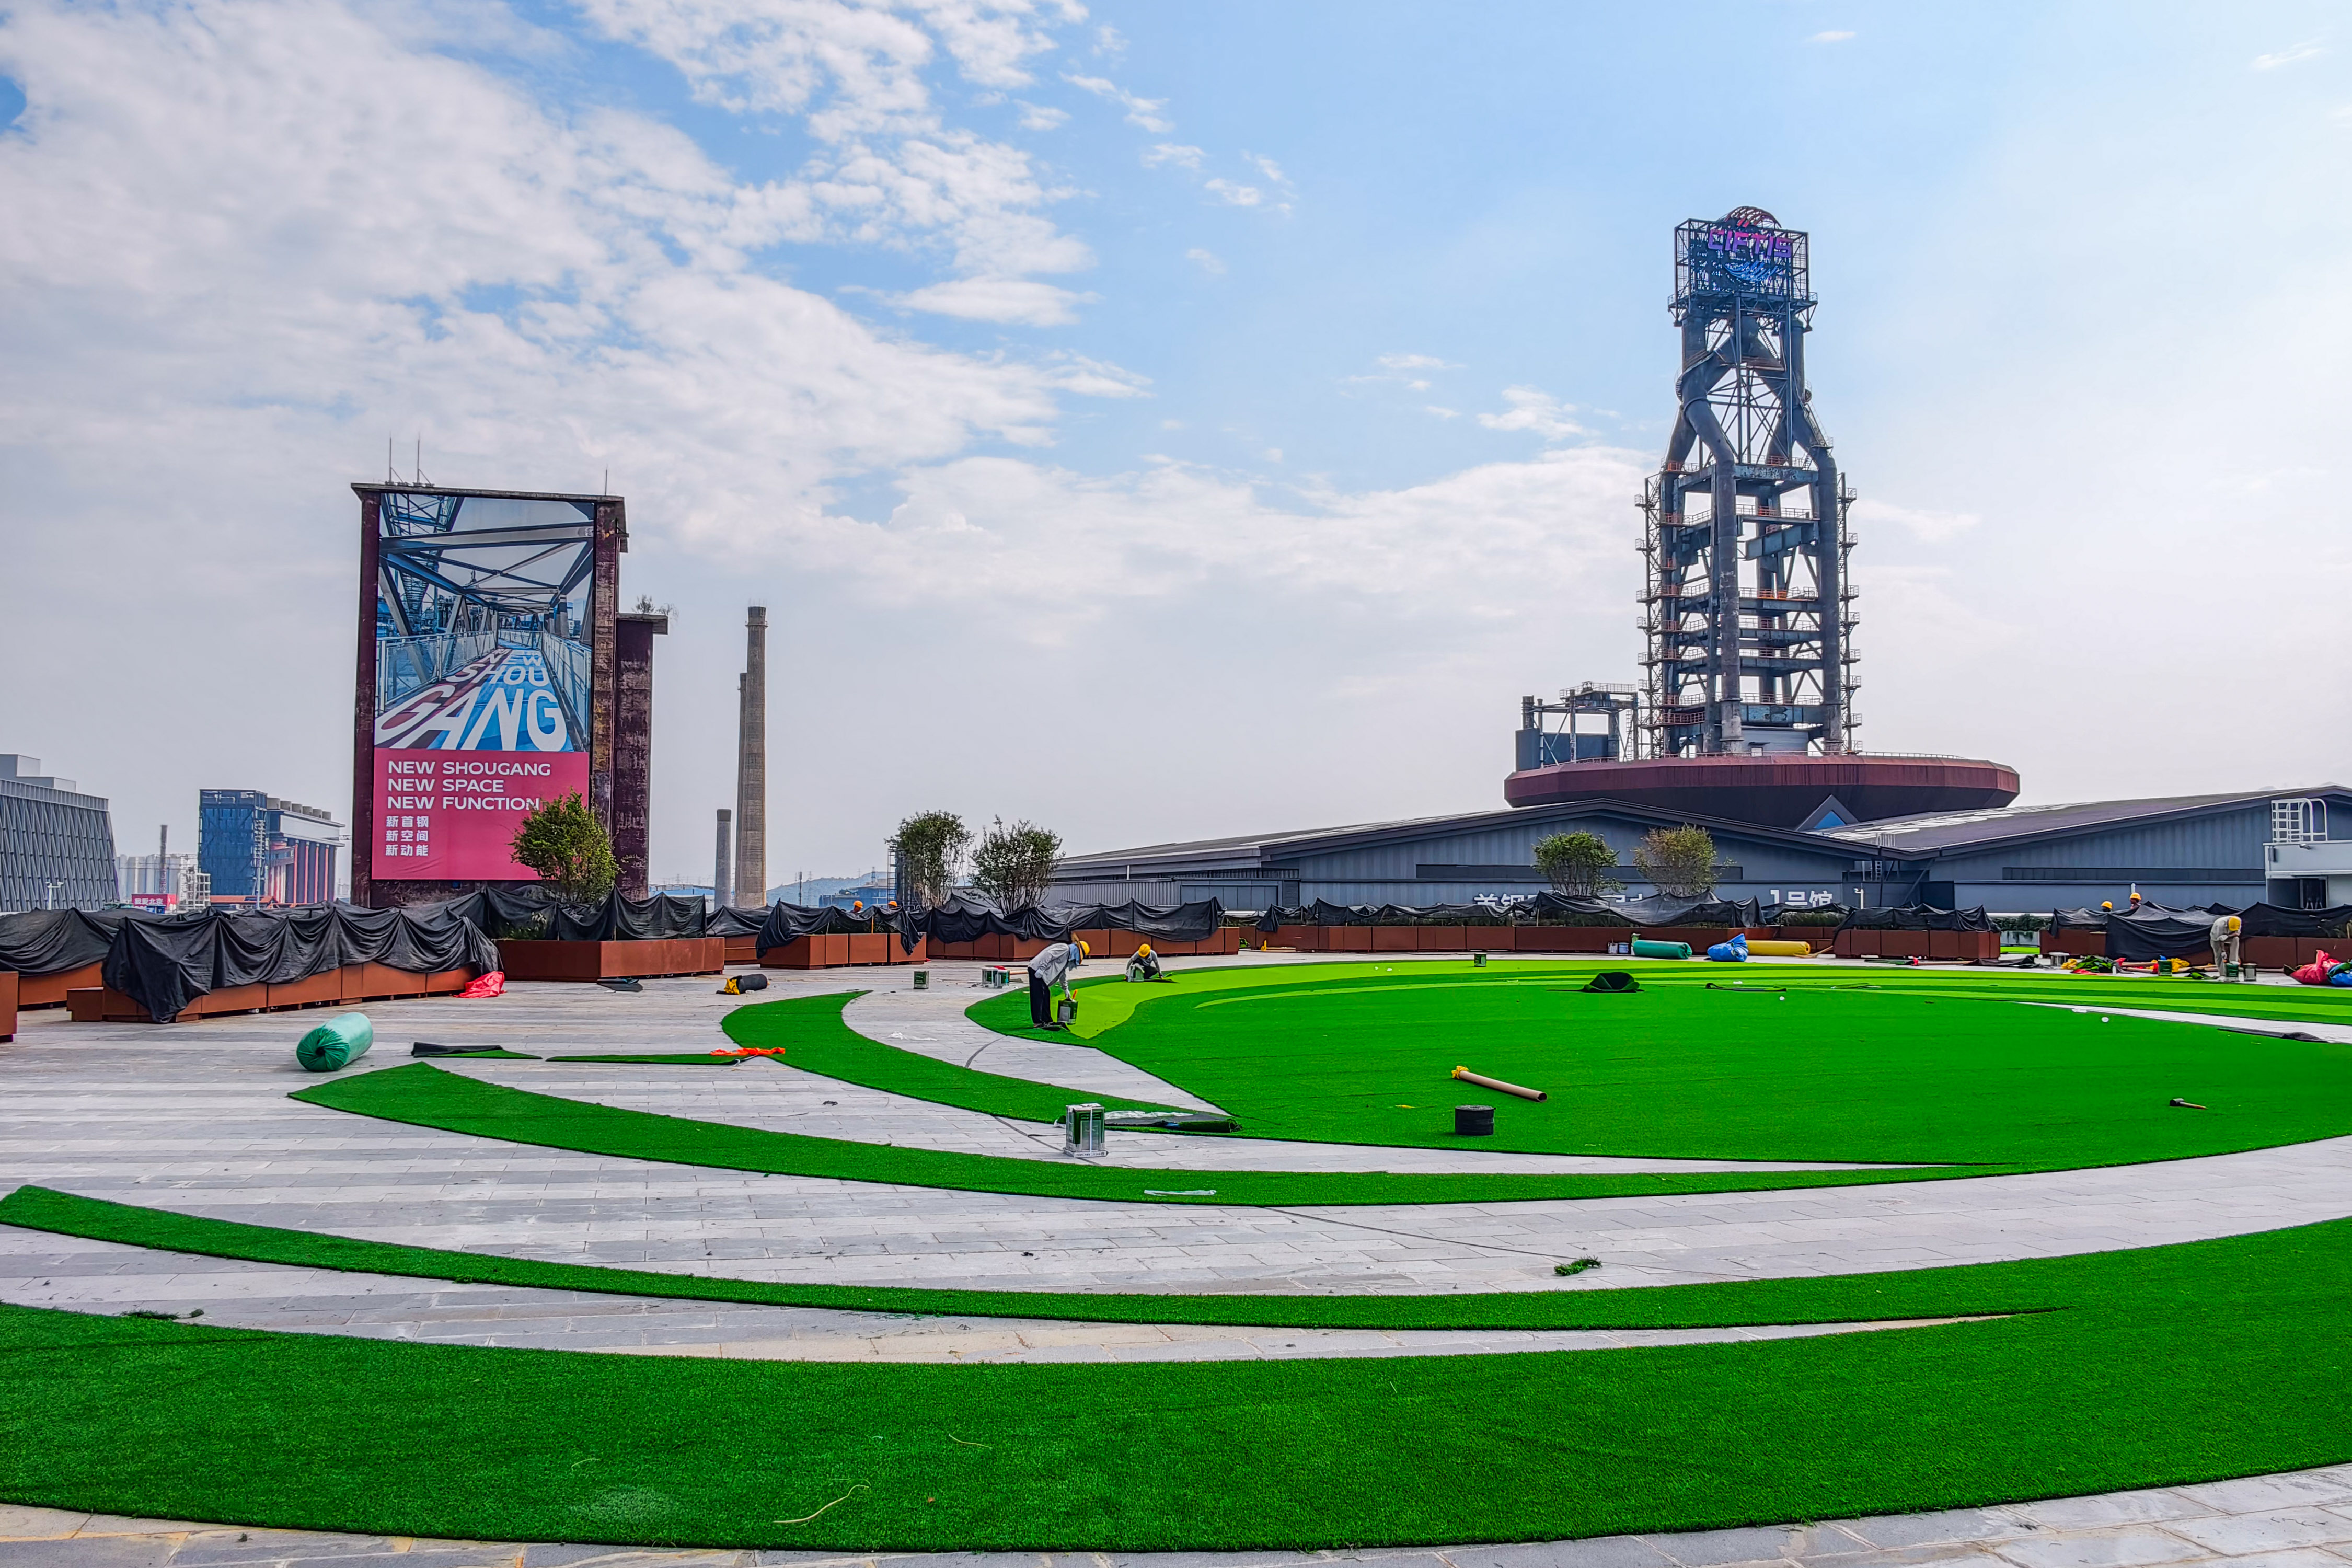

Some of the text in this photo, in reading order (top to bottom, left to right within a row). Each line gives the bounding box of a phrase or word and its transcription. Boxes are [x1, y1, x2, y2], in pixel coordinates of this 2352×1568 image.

[476, 650, 542, 666] NEW
[446, 663, 549, 686] SHOU
[374, 685, 567, 752] GANG
[388, 761, 551, 776] NEW SHOUGANG
[388, 779, 504, 792] NEW SPACE
[387, 797, 539, 810] NEW FUNCTION
[386, 816, 429, 827] 新首钢
[385, 830, 429, 842] 新空间
[385, 844, 429, 856] 新动能
